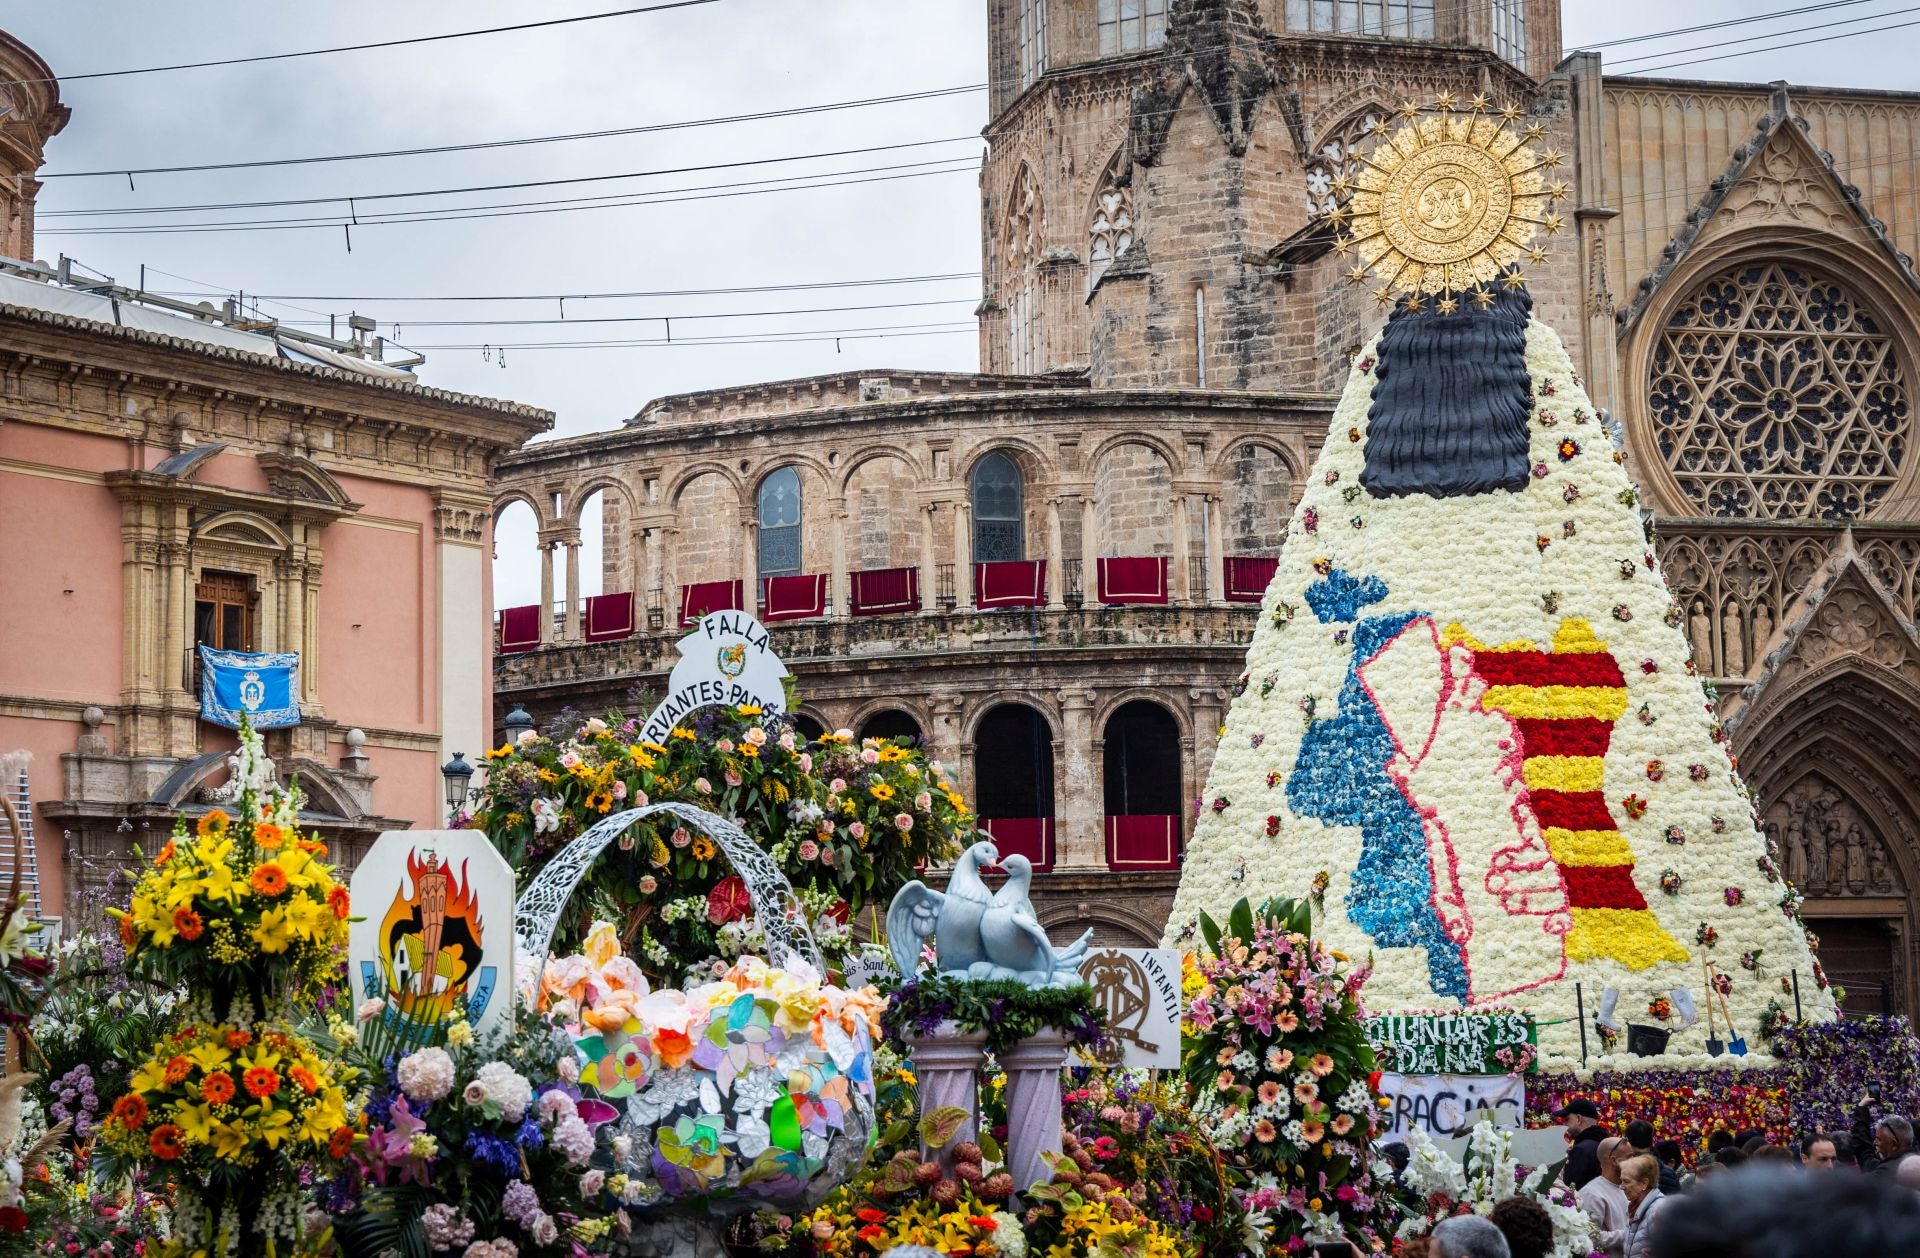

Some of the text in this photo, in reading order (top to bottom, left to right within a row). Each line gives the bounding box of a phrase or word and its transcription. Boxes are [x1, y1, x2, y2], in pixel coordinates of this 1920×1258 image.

[704, 614, 769, 655] FALLA
[643, 680, 724, 745] RVANTES
[863, 956, 885, 971] Sant
[1140, 951, 1179, 1024] INFANTIL
[1397, 1044, 1486, 1073] DANA
